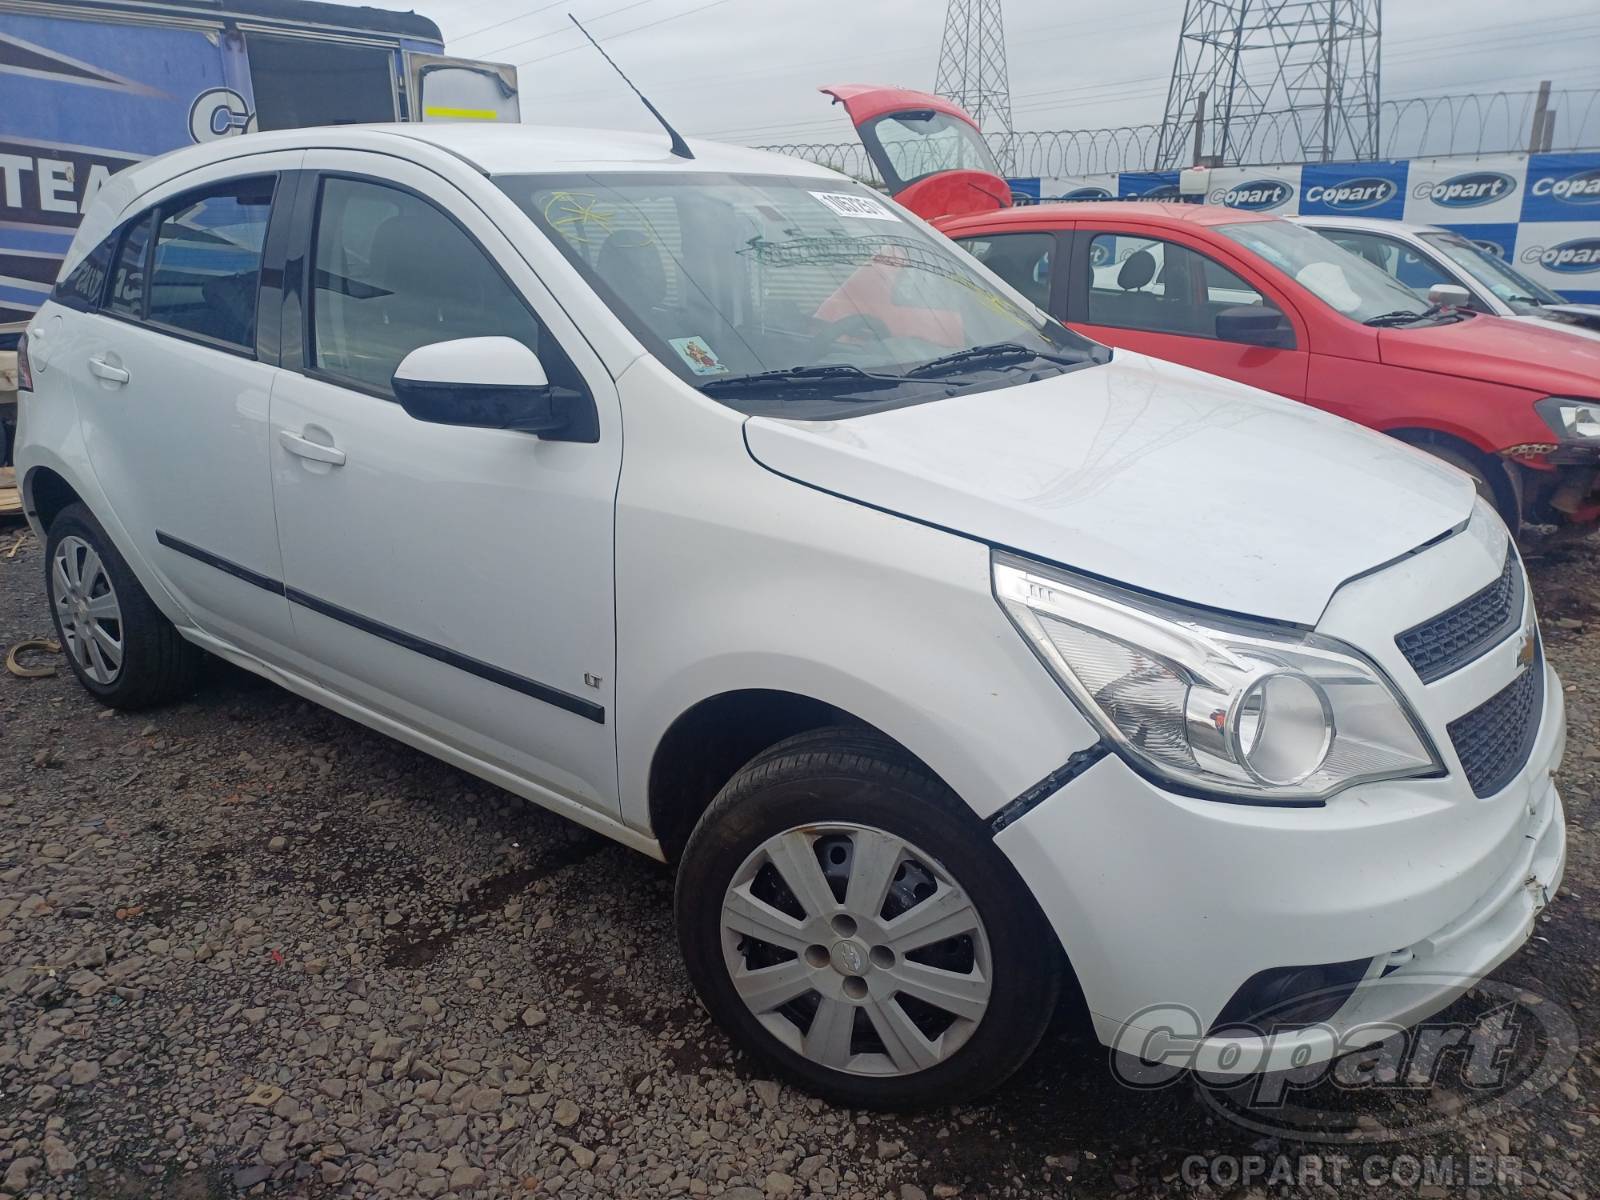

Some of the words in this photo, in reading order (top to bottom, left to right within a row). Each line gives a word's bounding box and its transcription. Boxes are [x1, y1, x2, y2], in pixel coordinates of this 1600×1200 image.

[1209, 185, 1282, 209] Copart
[1306, 183, 1387, 206] Copart
[1412, 178, 1503, 201] Copart
